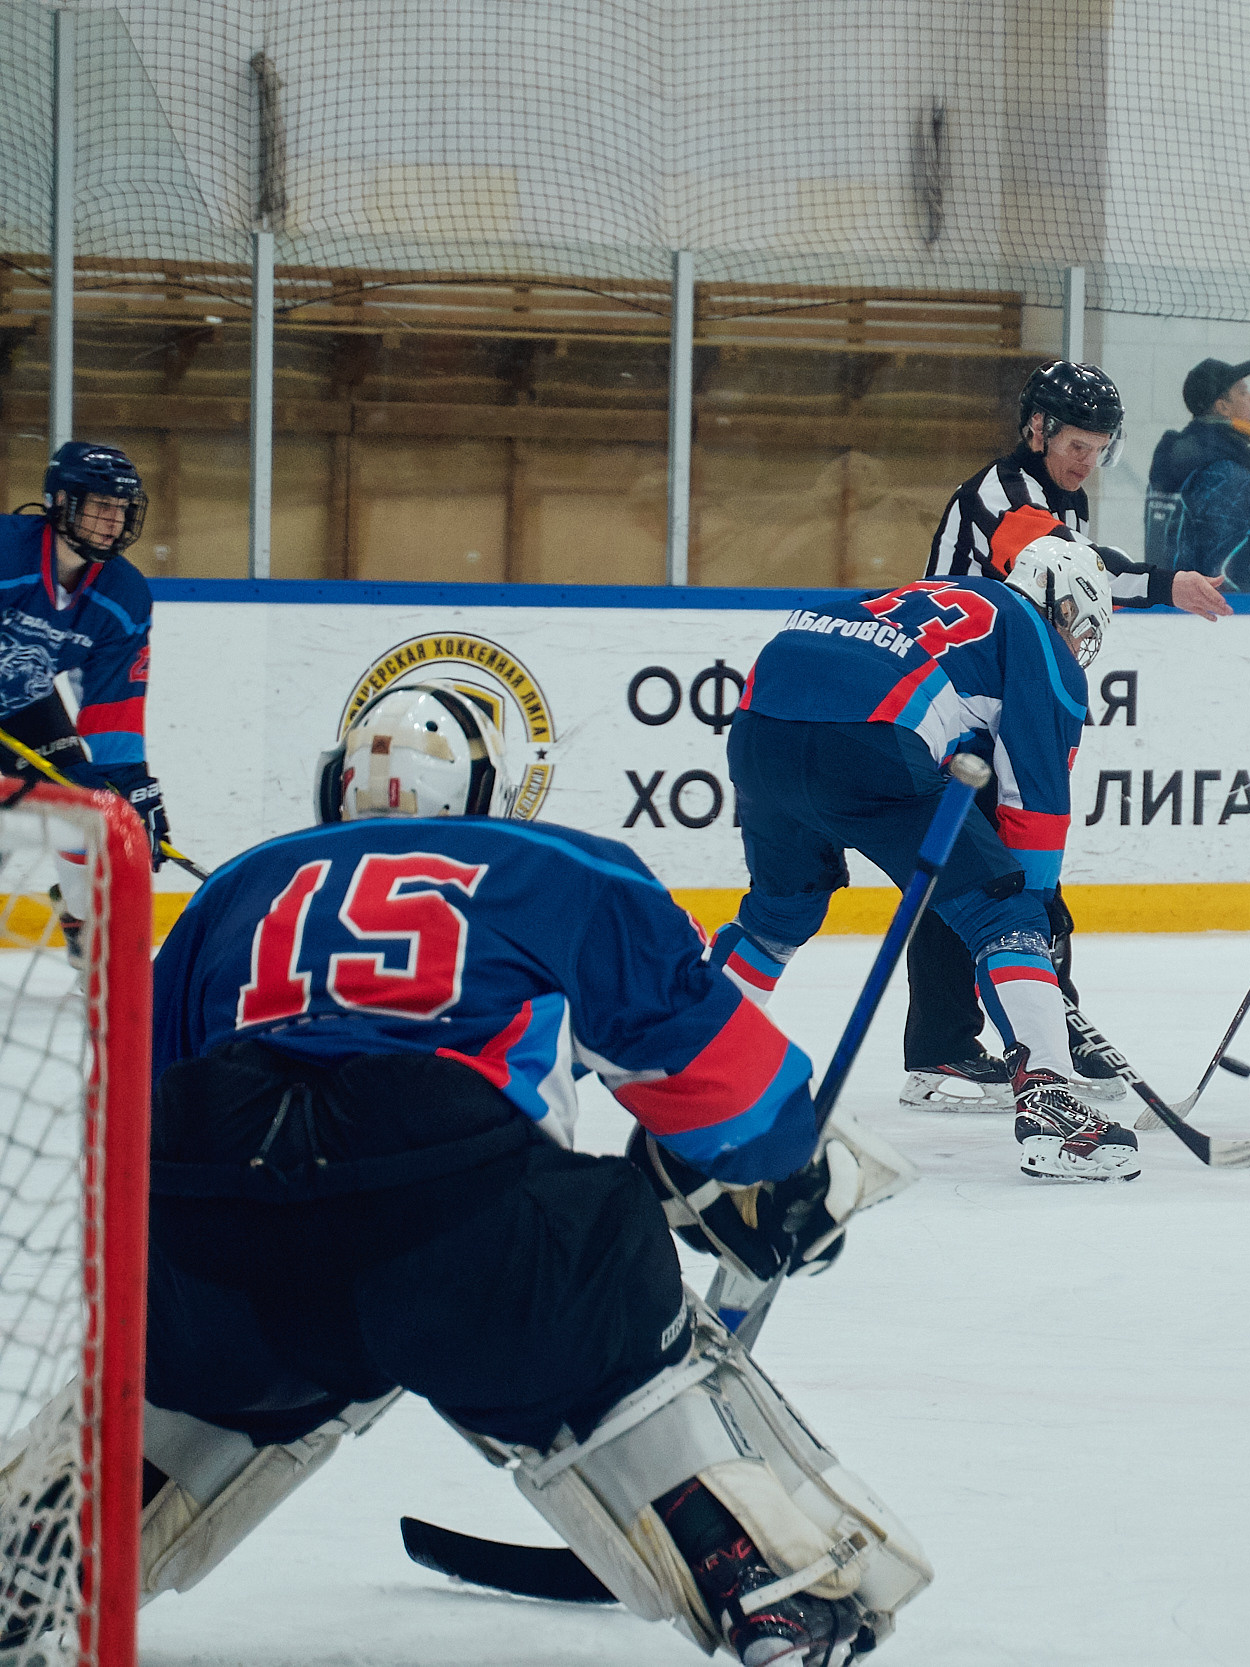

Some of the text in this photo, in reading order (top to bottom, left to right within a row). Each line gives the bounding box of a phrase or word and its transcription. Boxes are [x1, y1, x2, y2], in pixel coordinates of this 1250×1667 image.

[784, 609, 915, 659] АБАРОВСК
[520, 690, 548, 736] ЛИГА
[236, 852, 489, 1030] 15
